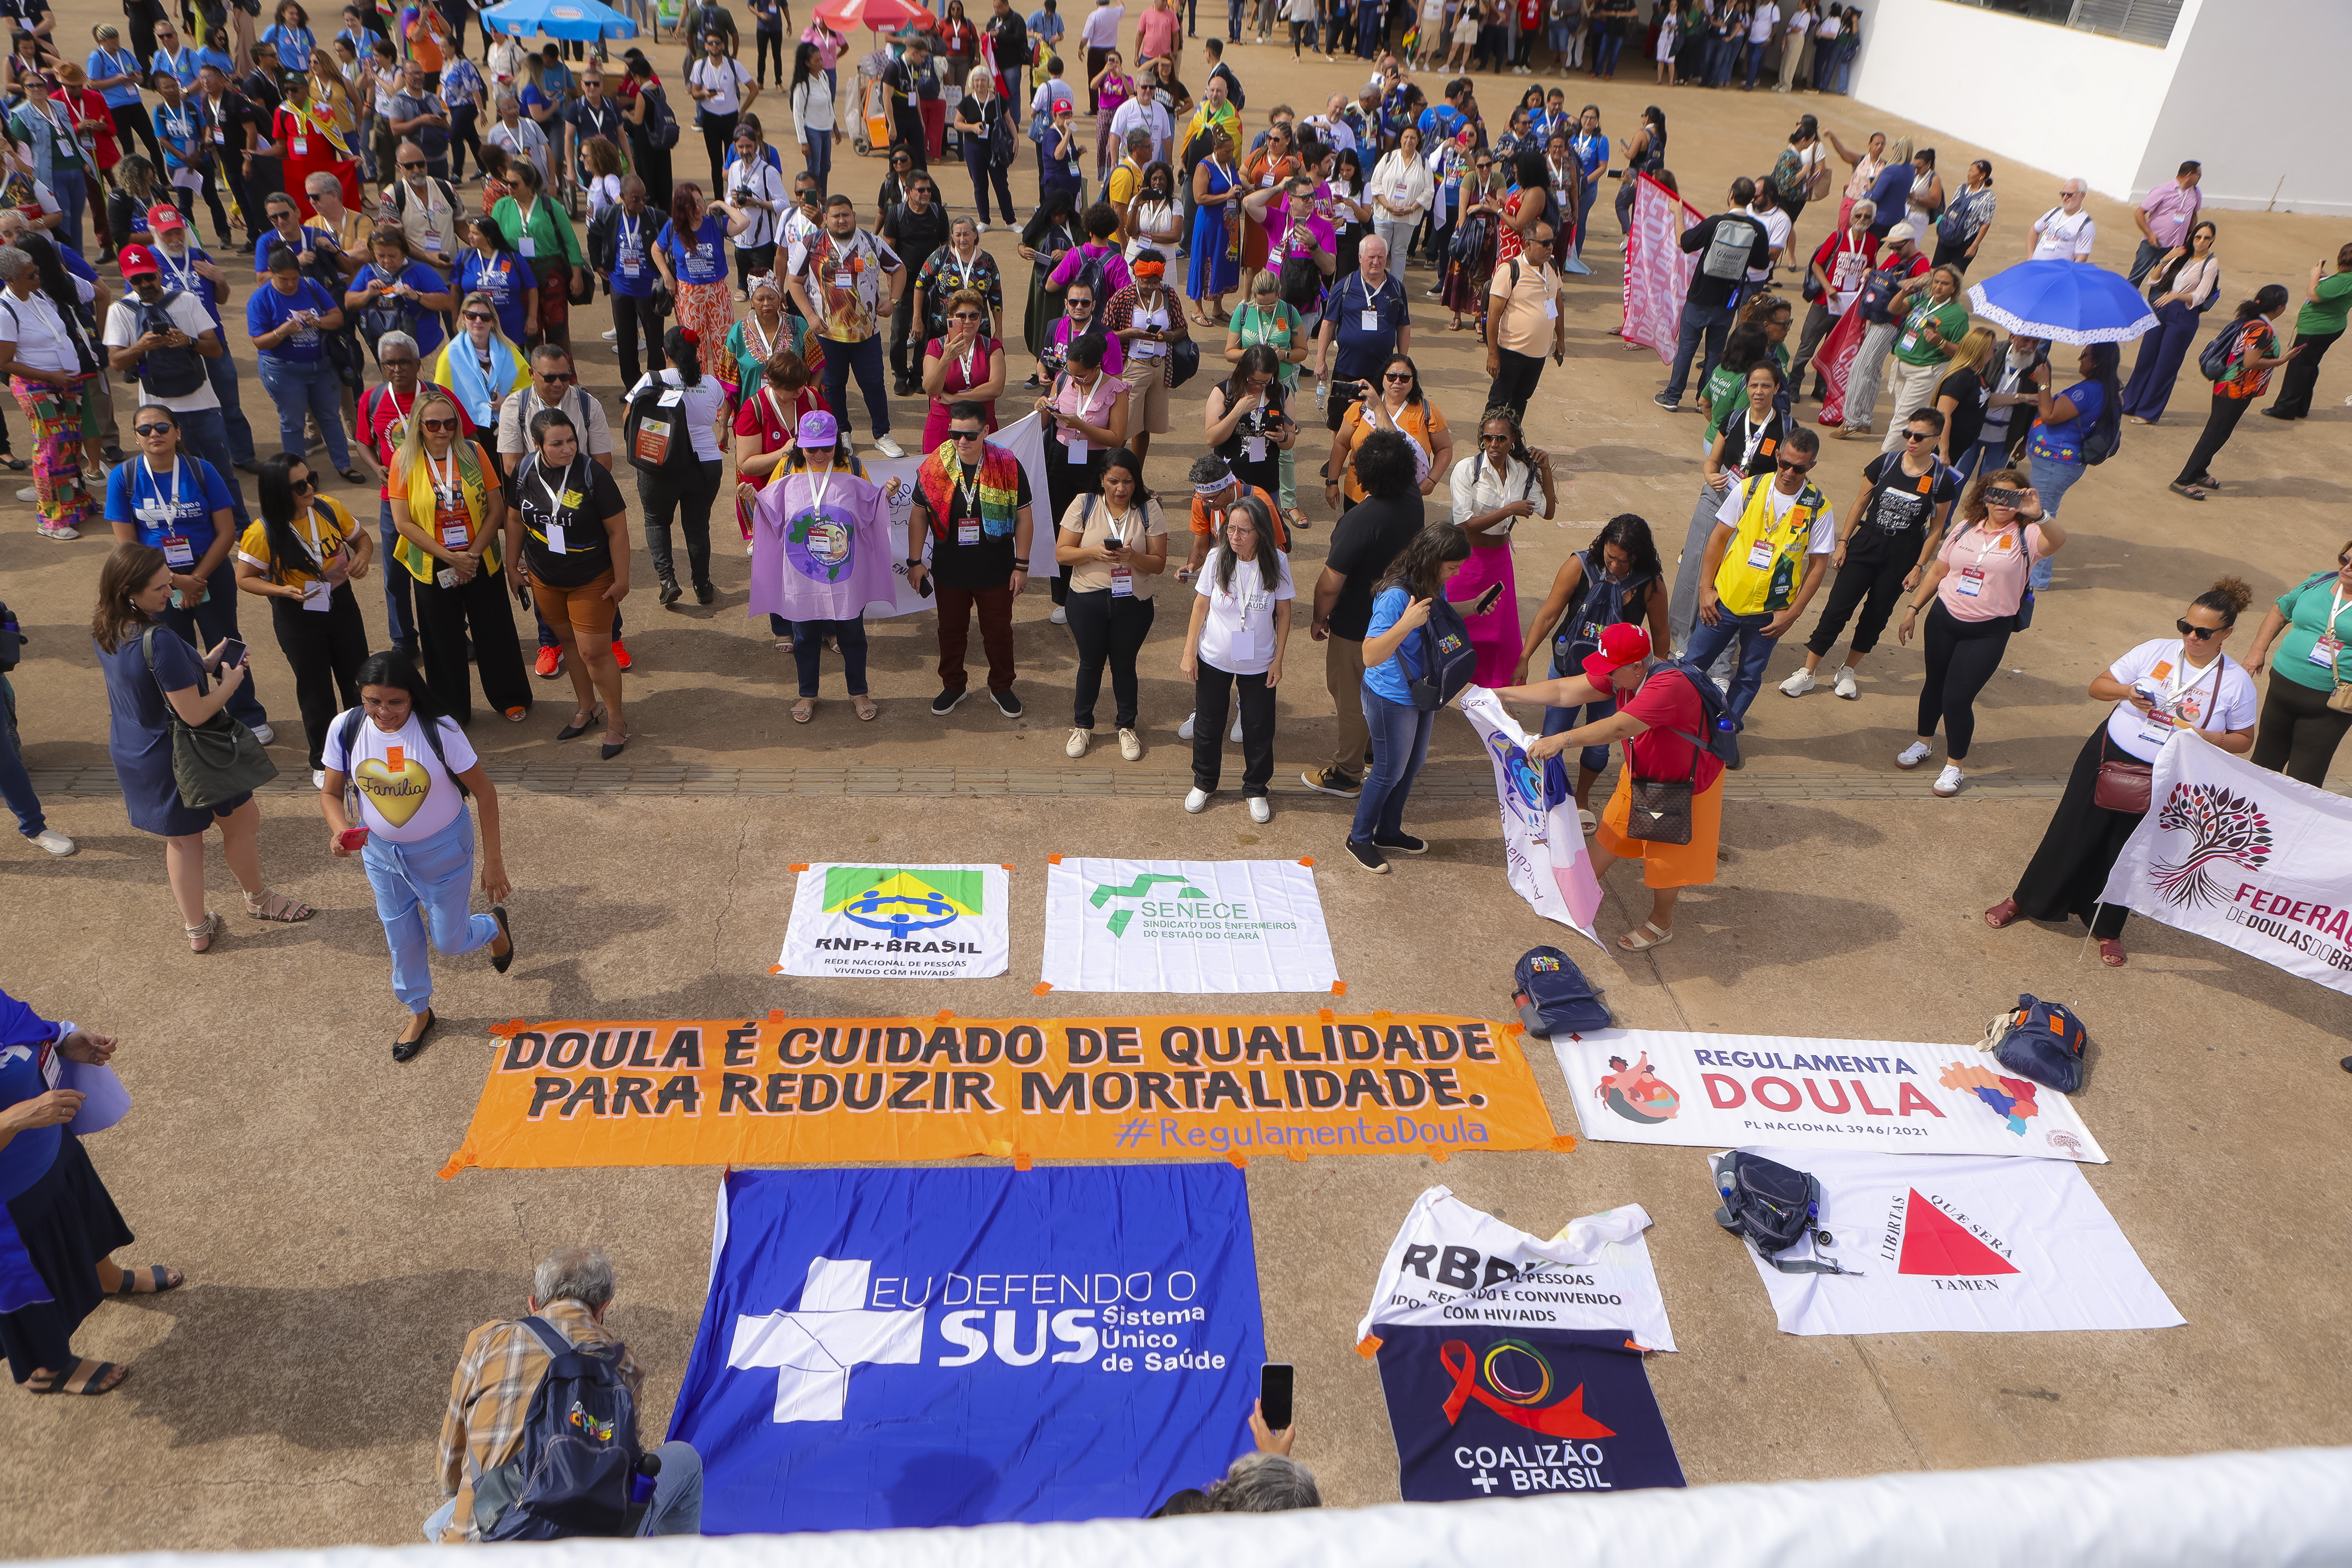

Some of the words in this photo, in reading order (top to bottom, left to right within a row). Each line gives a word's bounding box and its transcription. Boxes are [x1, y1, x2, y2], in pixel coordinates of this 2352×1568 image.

[357, 775, 427, 797] Família
[1141, 901, 1249, 919] SENECE
[1143, 920, 1196, 929] SINDICATO
[1225, 922, 1297, 930] ENFERMEIROS
[1223, 930, 1259, 940] CEARÁ
[815, 937, 982, 954] RNP+BRASIL
[501, 1028, 704, 1070] DOULA
[723, 1021, 758, 1066] É
[778, 1026, 1046, 1066] CUIDADO
[1065, 1026, 1143, 1065] DE
[1159, 1023, 1499, 1068] QUALIDADE
[1694, 1048, 1918, 1075] REGULAMENTA
[527, 1075, 704, 1119] PARA
[718, 1070, 1005, 1116] REDUZIR
[1021, 1067, 1487, 1113] MORTALIDADE.
[1701, 1073, 1947, 1118] DOULA
[1114, 1115, 1488, 1152] #RegulamentaDoula
[1744, 1120, 1762, 1129] PL
[1763, 1121, 1844, 1133] NACIONAL
[1847, 1124, 1928, 1136] 3946/2021
[1968, 1223, 2014, 1260] SERA
[872, 1277, 933, 1308] EU
[943, 1271, 1152, 1305] DEFENDO
[1167, 1270, 1196, 1302] O
[1526, 1273, 1594, 1285] PESSOAS
[1932, 1279, 2000, 1291] TAMEN
[1501, 1291, 1510, 1301] E
[1514, 1291, 1622, 1305] CONVIVENDO
[1102, 1305, 1205, 1327] Sistema
[1443, 1307, 1480, 1320] COM
[1484, 1309, 1557, 1321] HIV/AIDS
[939, 1308, 1098, 1367] SUS
[1101, 1321, 1178, 1350] Único
[1101, 1353, 1133, 1372] de
[1144, 1348, 1226, 1372] Saúde
[1454, 1439, 1603, 1469] COALIZÃO
[1510, 1468, 1612, 1490] BRASIL
